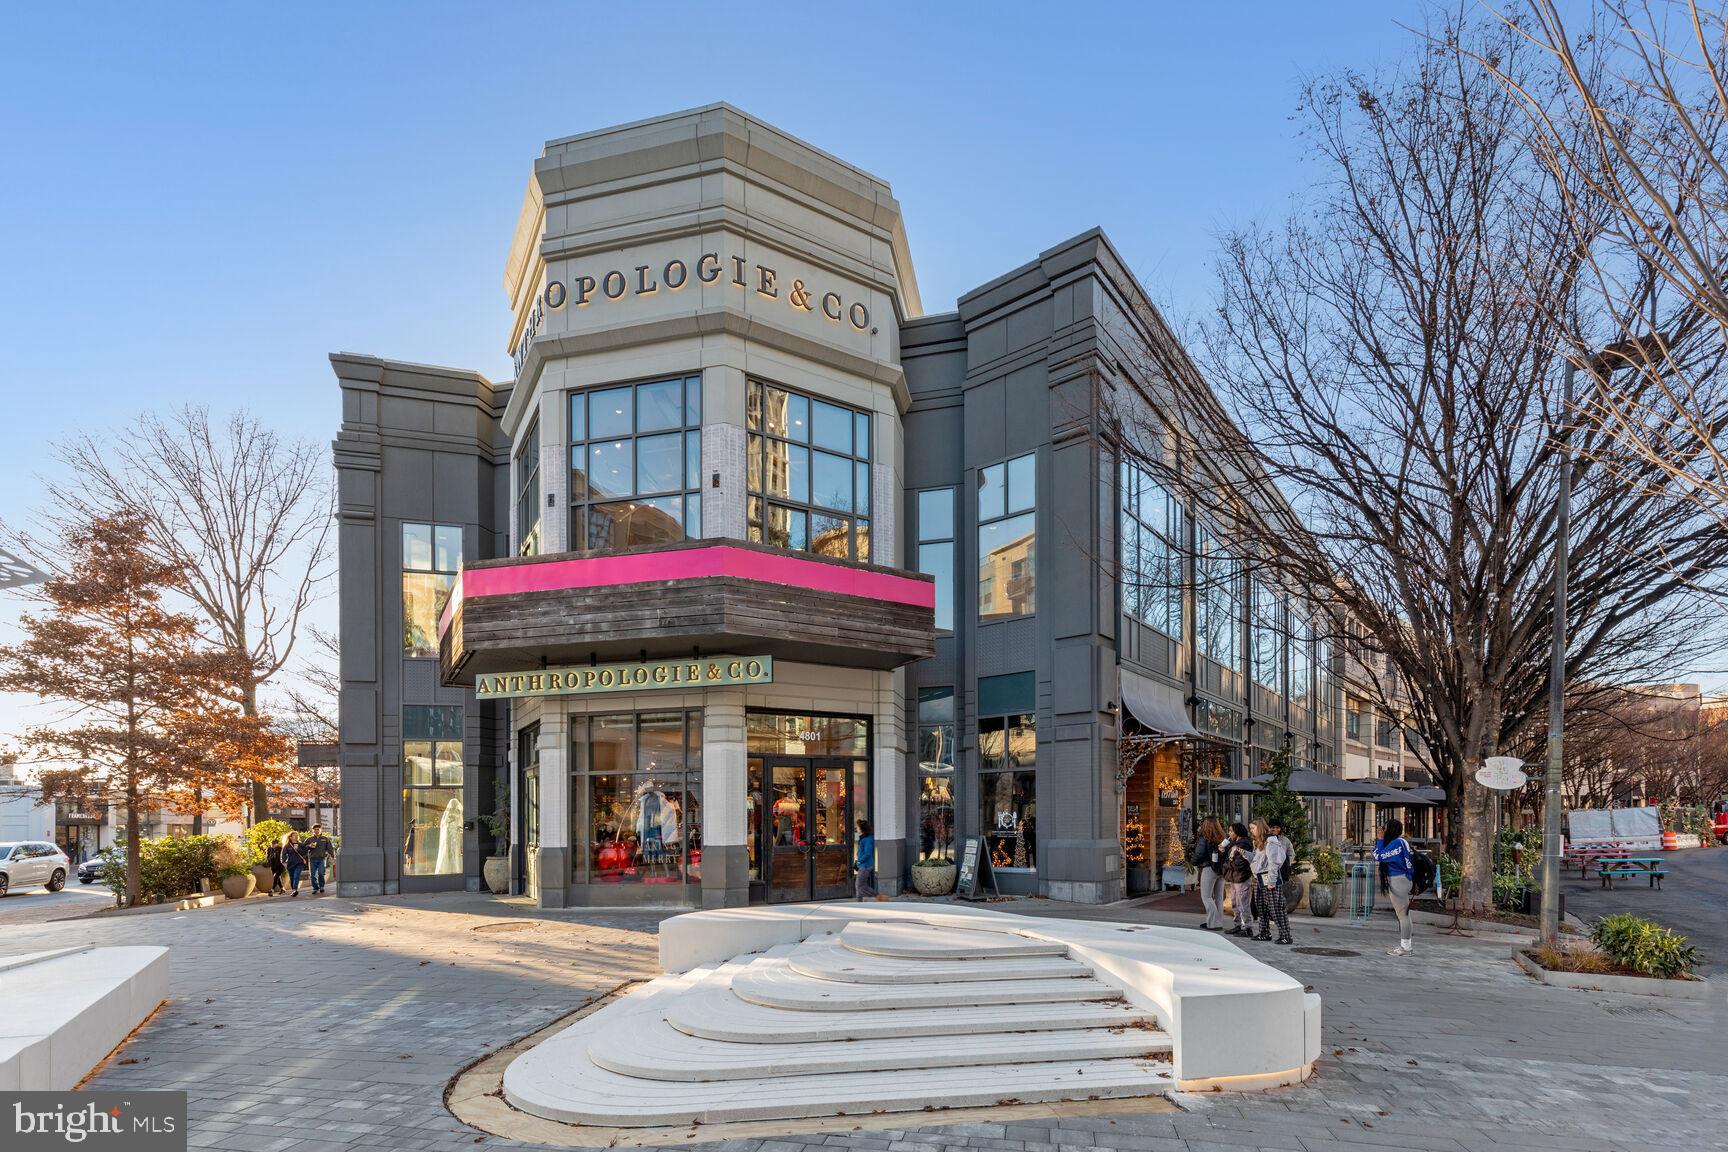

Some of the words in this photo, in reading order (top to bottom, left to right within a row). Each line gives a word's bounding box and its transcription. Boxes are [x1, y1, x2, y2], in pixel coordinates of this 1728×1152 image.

[790, 279, 813, 311] &
[822, 292, 879, 335] CO.
[476, 665, 699, 694] ANTHROPOLOGIE
[706, 663, 722, 680] &
[727, 660, 769, 679] CO.
[800, 731, 820, 741] 4801
[643, 855, 679, 863] MERRY
